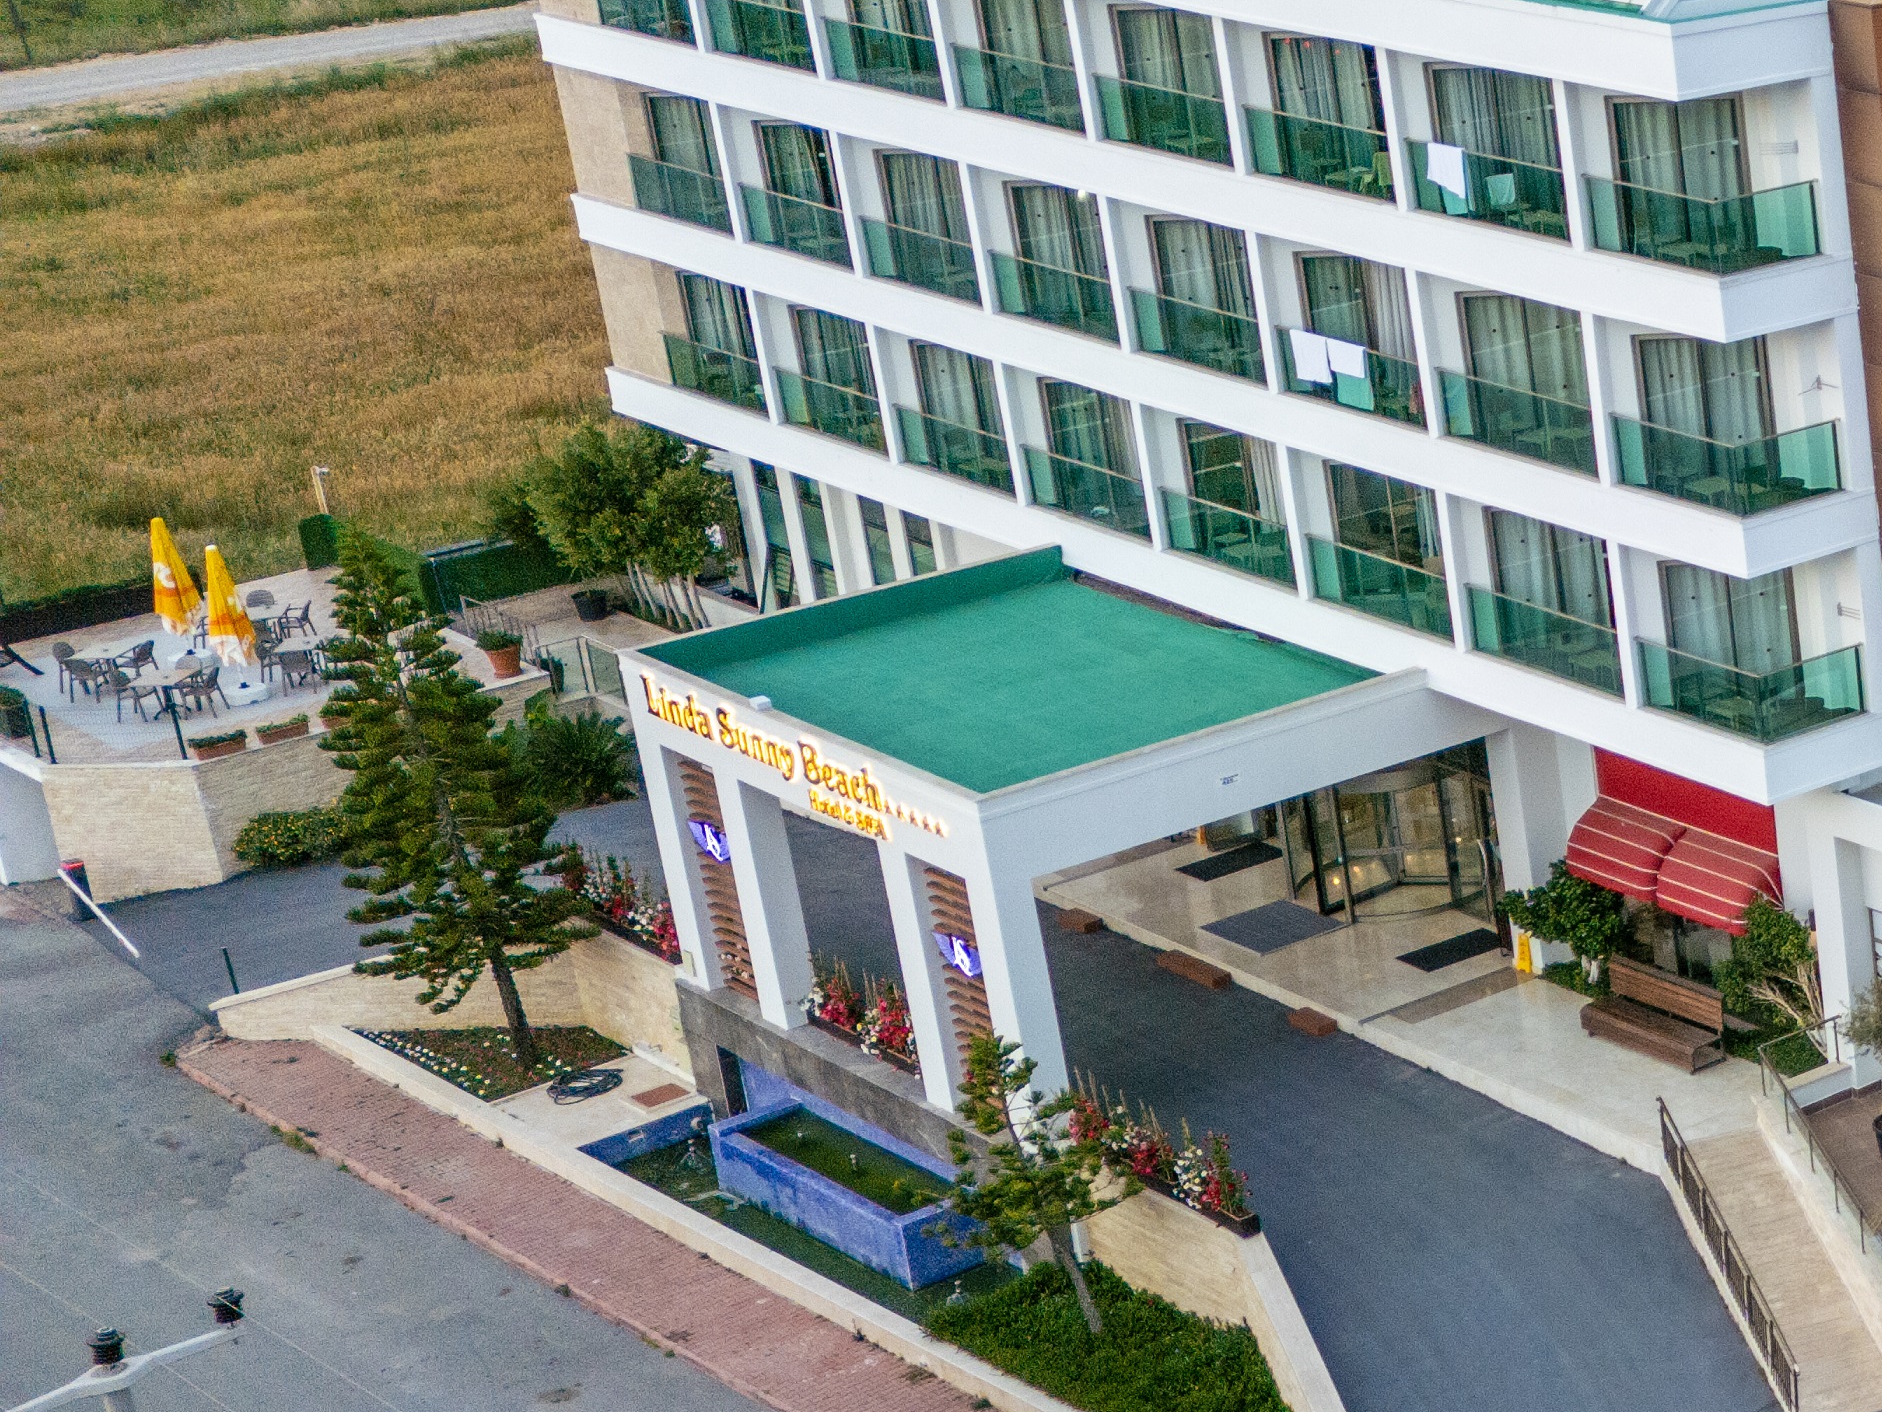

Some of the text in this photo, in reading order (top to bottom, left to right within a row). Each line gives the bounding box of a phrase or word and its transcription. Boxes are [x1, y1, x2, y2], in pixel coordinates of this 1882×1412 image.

[640, 673, 886, 813] Linda Sunny Beach
